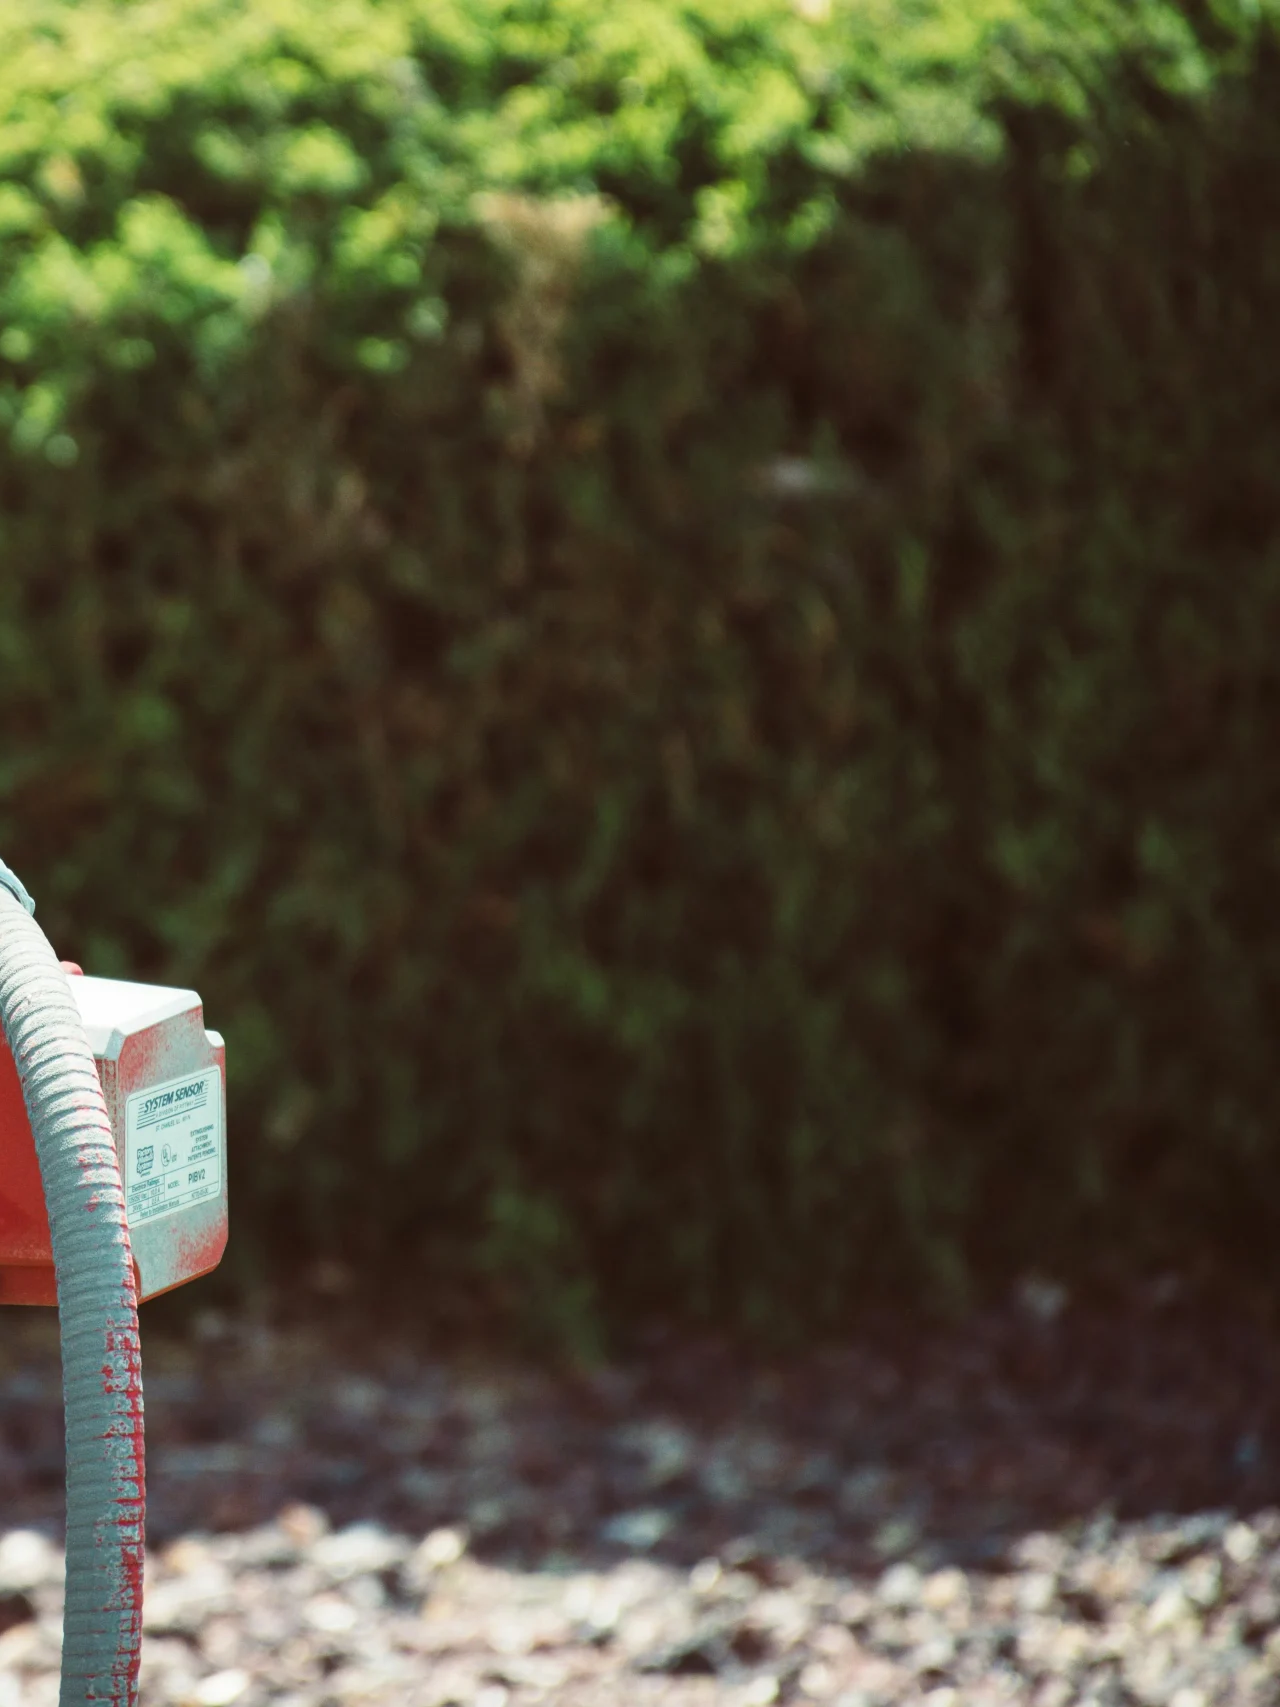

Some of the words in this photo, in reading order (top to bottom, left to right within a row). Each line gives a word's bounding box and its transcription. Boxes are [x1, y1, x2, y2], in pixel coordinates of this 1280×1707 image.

[144, 1090, 174, 1113] SYSTEM
[175, 1080, 205, 1102] SENSOR
[190, 1124, 214, 1137] EXTINGUISHING
[195, 1134, 208, 1143] SYSTEM
[191, 1140, 212, 1153] ATTACHMENT
[188, 1169, 206, 1185] PIBV2
